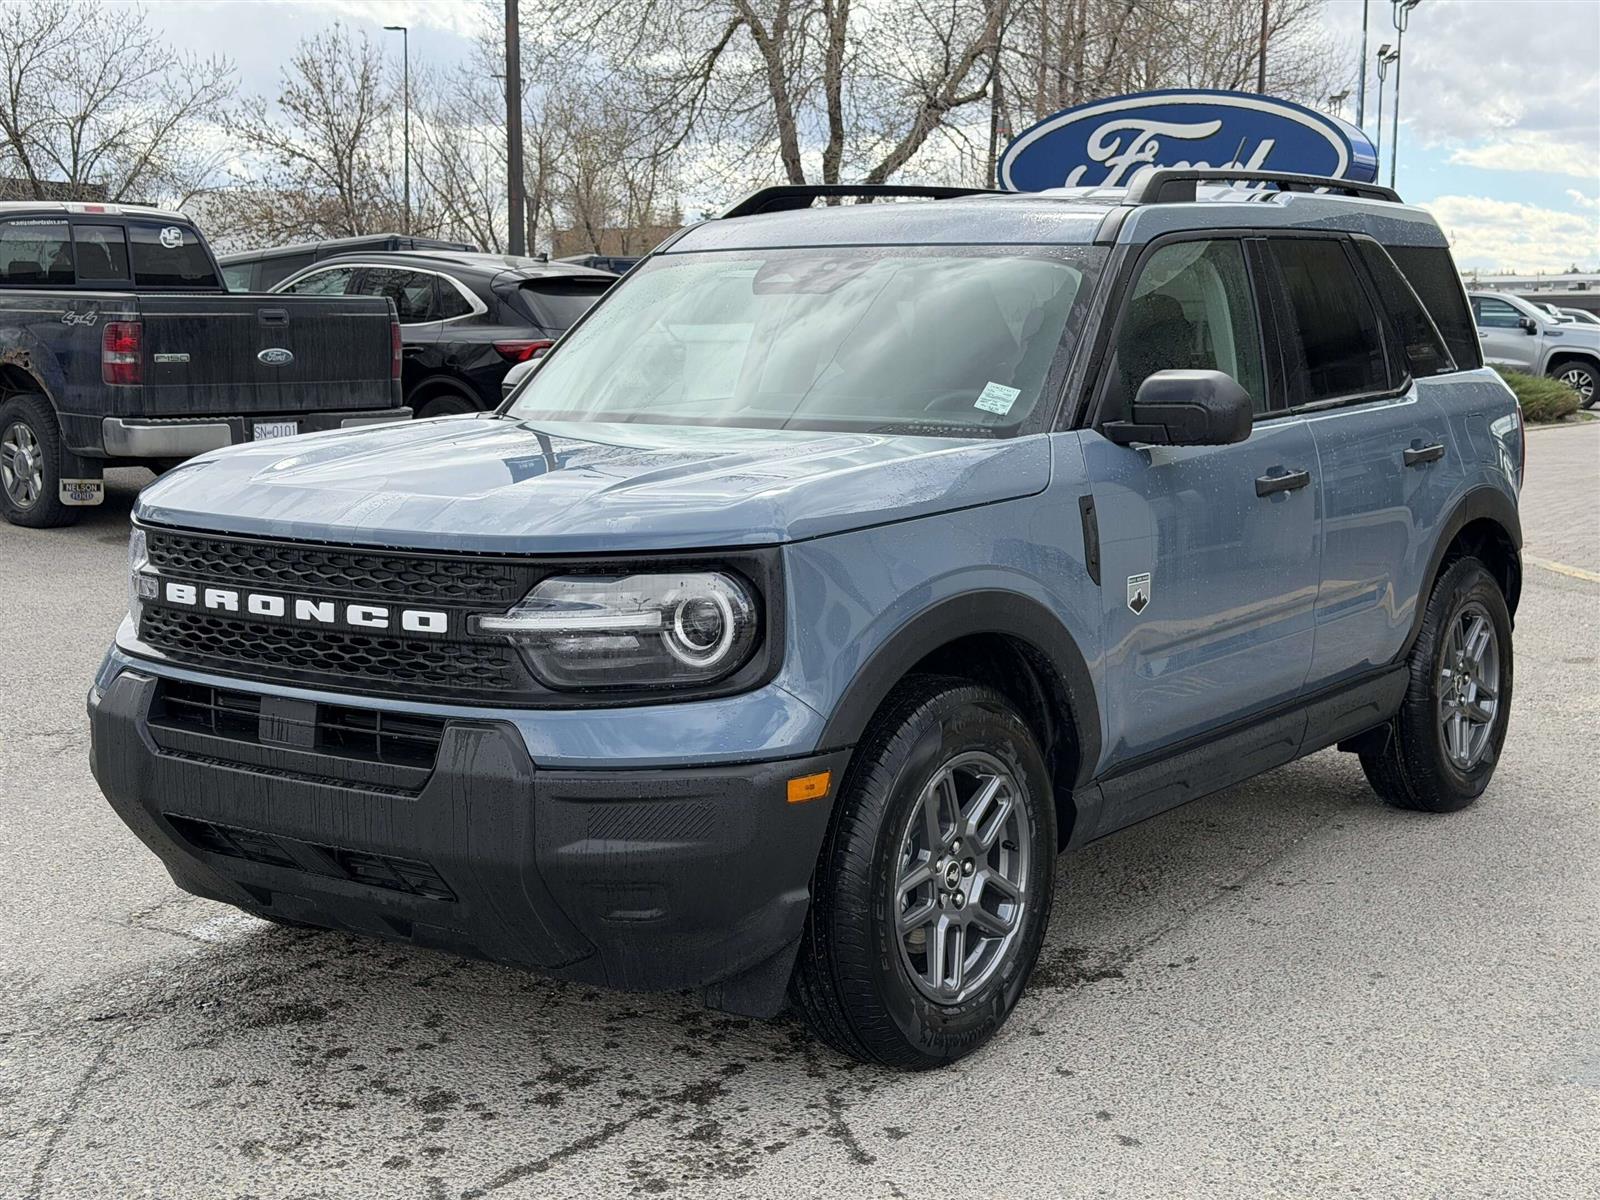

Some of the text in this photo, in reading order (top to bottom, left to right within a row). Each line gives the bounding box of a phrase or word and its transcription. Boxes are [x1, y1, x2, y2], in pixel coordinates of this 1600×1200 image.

[1065, 119, 1275, 189] Fd
[65, 483, 98, 491] NELSON
[166, 583, 448, 634] BRONCO
